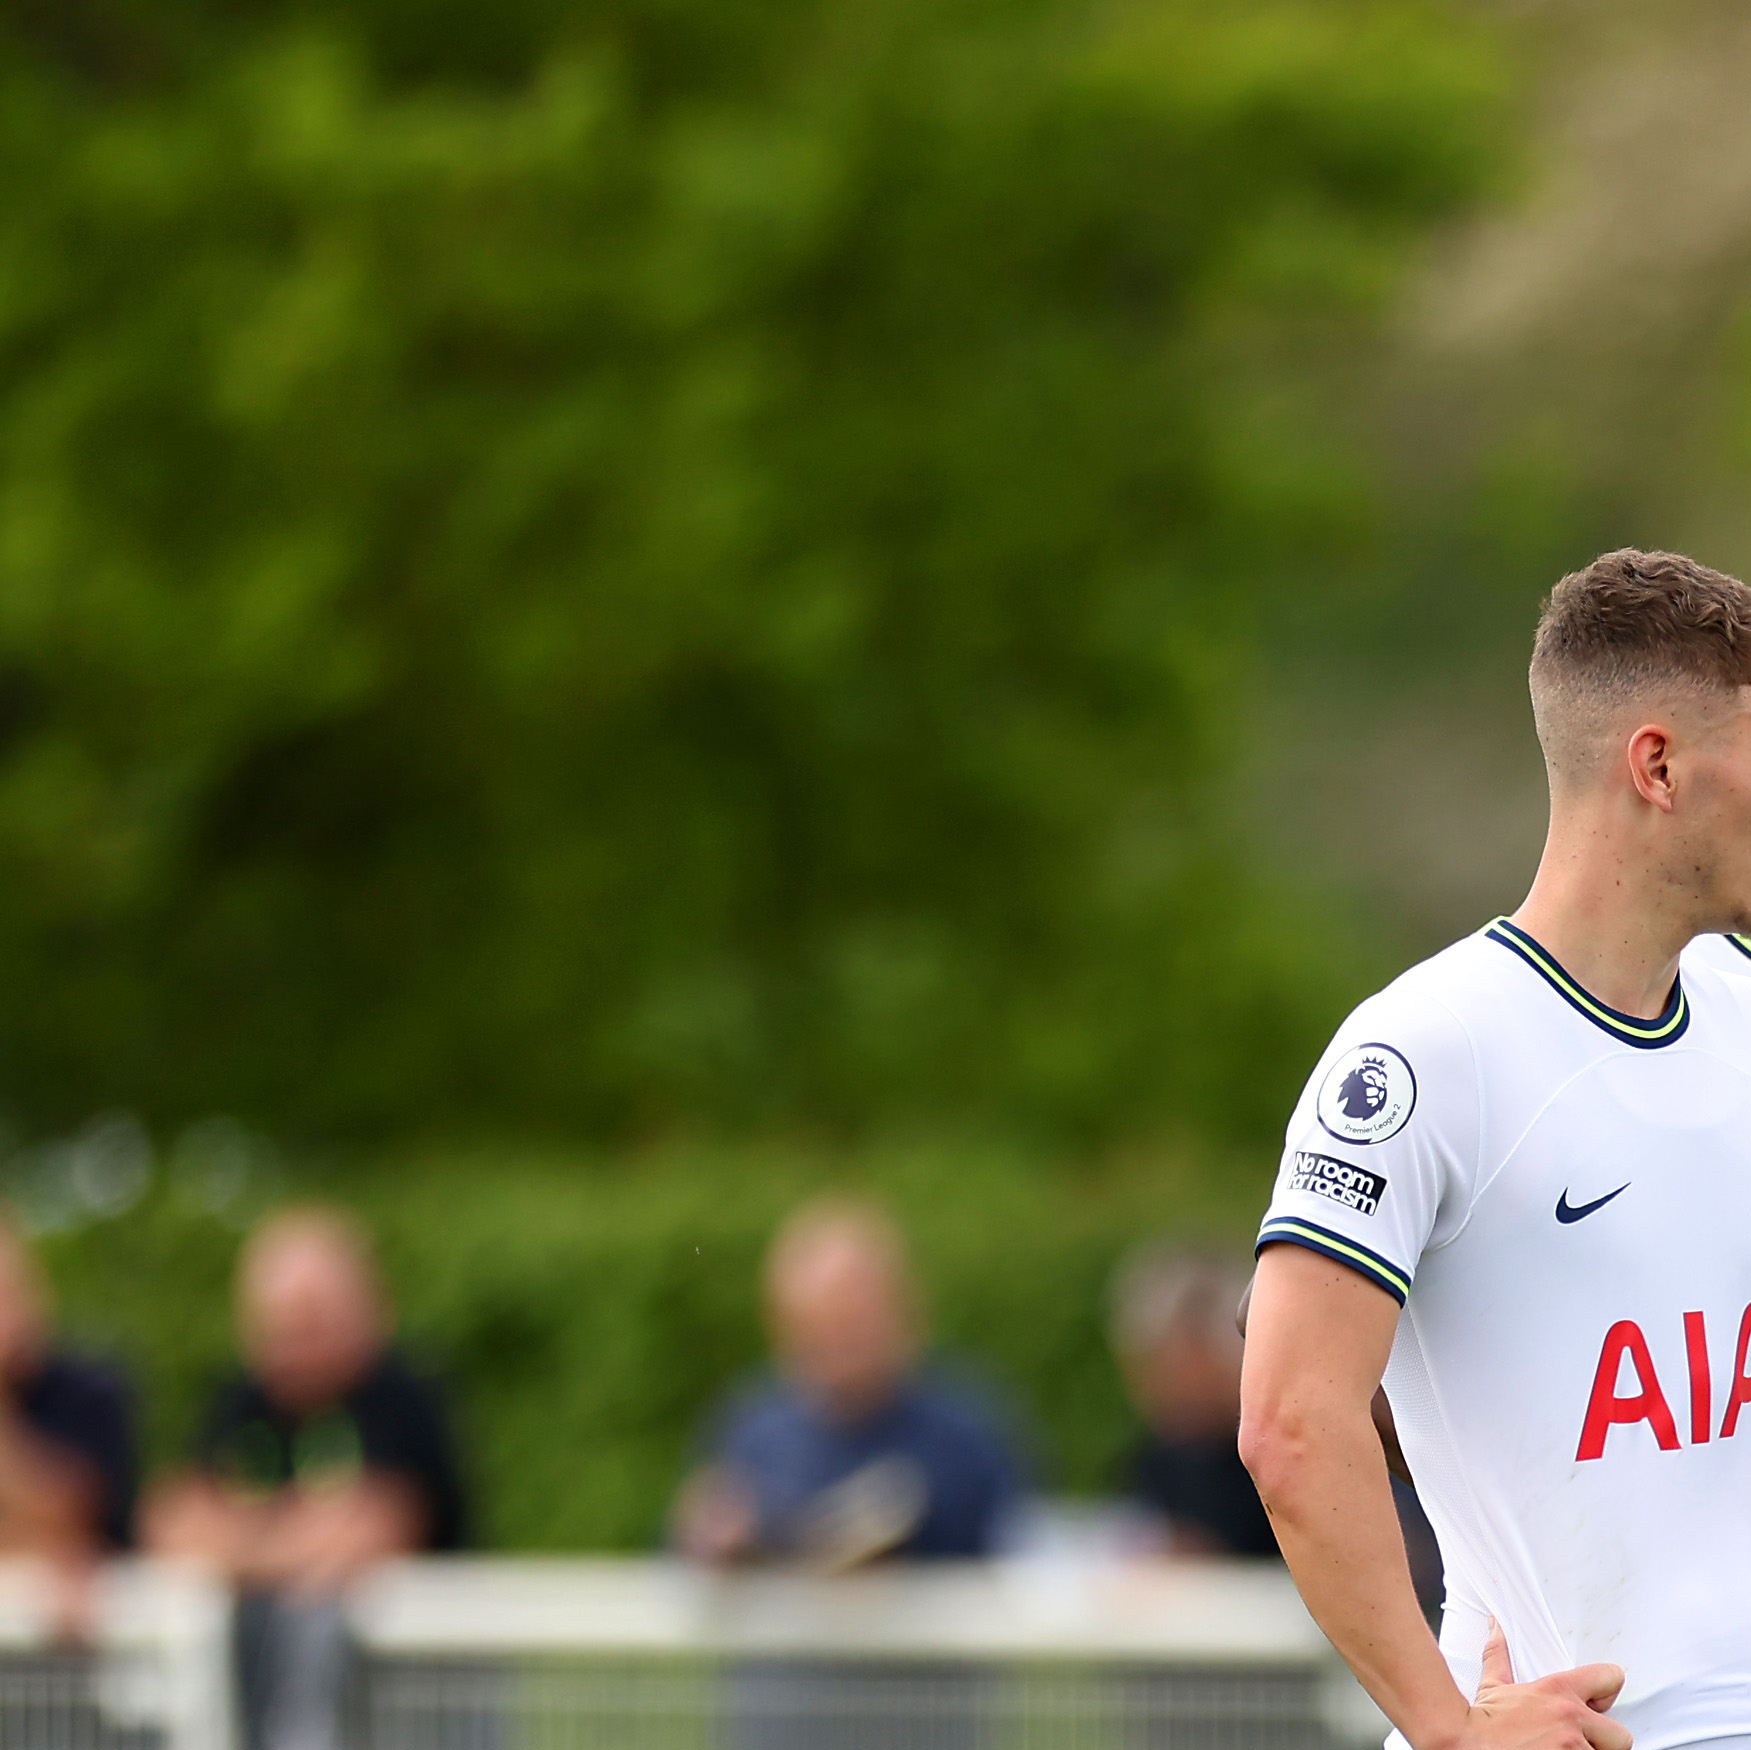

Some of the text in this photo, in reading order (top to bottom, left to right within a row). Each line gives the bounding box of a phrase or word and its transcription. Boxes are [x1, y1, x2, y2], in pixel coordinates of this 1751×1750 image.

[1345, 1123, 1373, 1134] Premier
[1373, 1110, 1398, 1131] League
[1294, 1152, 1374, 1195] No room
[1306, 1174, 1377, 1215] racism
